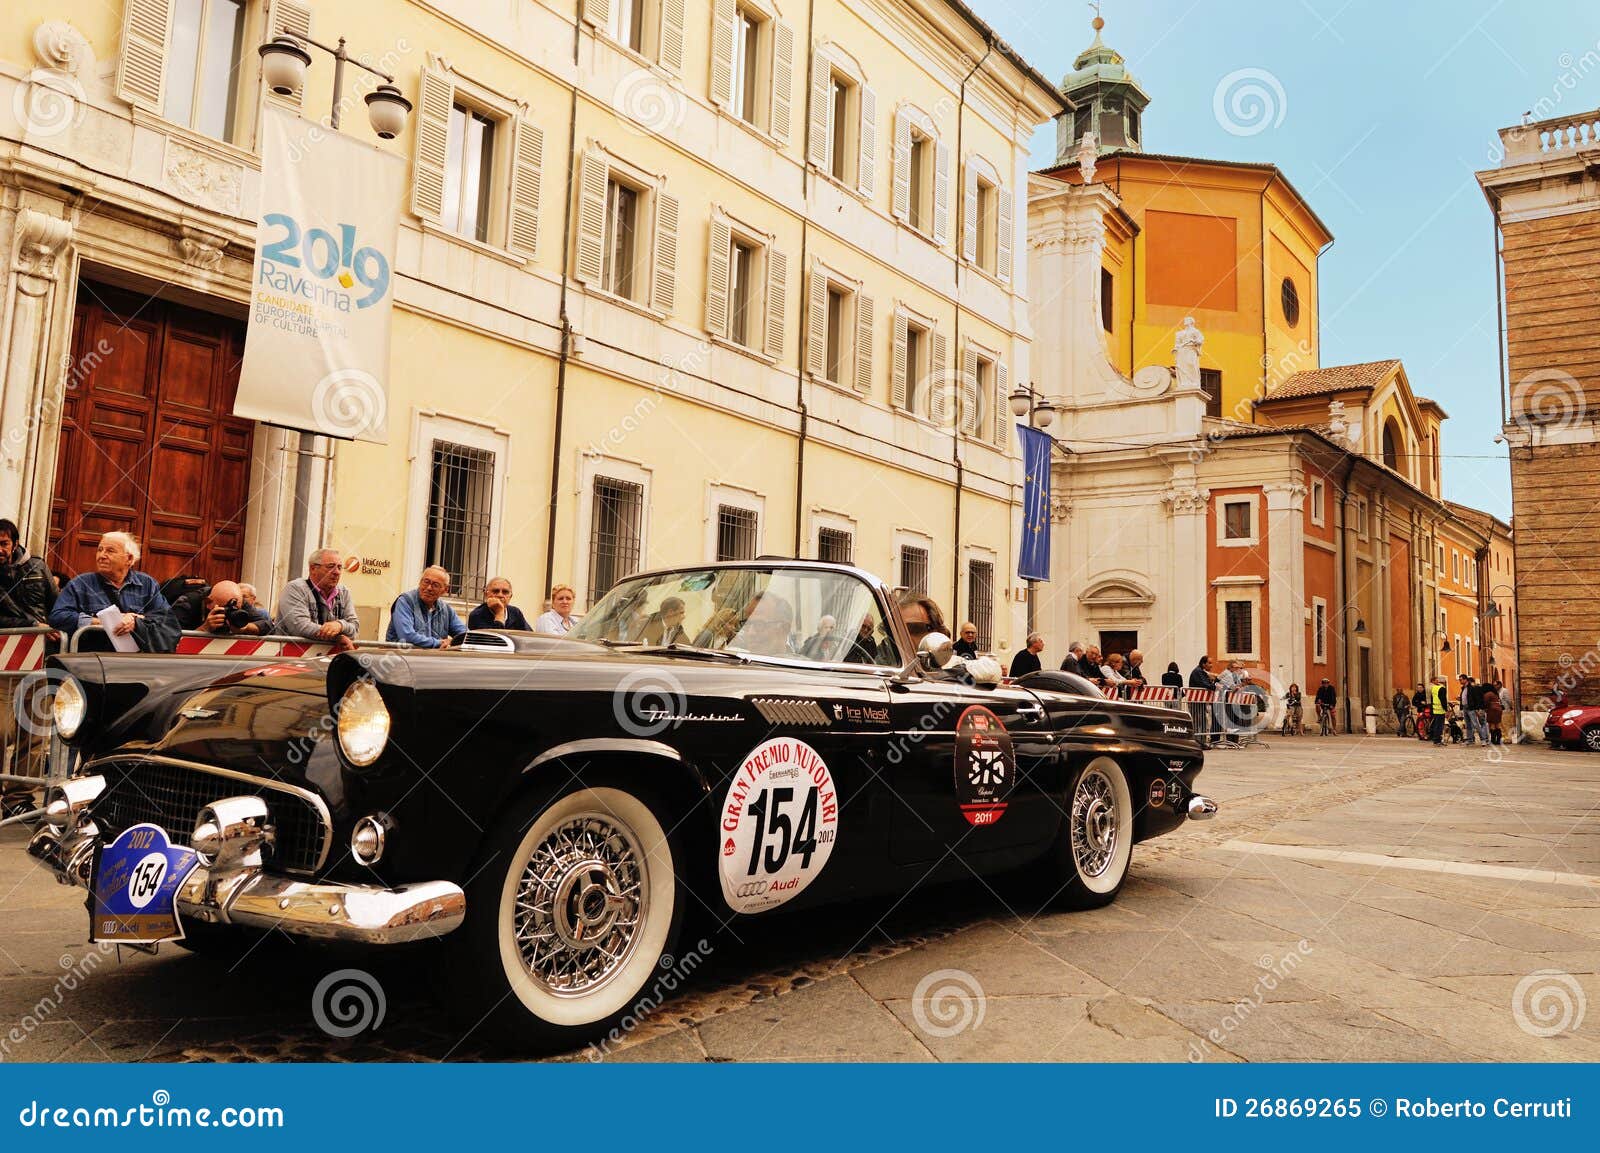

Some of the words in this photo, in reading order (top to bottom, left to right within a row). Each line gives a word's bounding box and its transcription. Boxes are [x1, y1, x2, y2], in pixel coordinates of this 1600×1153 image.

[259, 259, 351, 313] Ravenna
[256, 303, 312, 325] EUROPEAN
[255, 313, 271, 325] OF
[272, 317, 319, 338] CULTURE
[639, 710, 745, 723] Thunderbird
[722, 777, 751, 832] GRAN
[745, 743, 790, 782] PREMIO
[793, 743, 836, 825] NUVOLARI
[974, 812, 993, 823] 2011
[127, 830, 156, 849] 2012
[747, 786, 819, 876] 154
[818, 830, 834, 844] 2012
[131, 862, 165, 897] 154
[769, 877, 800, 892] Audi
